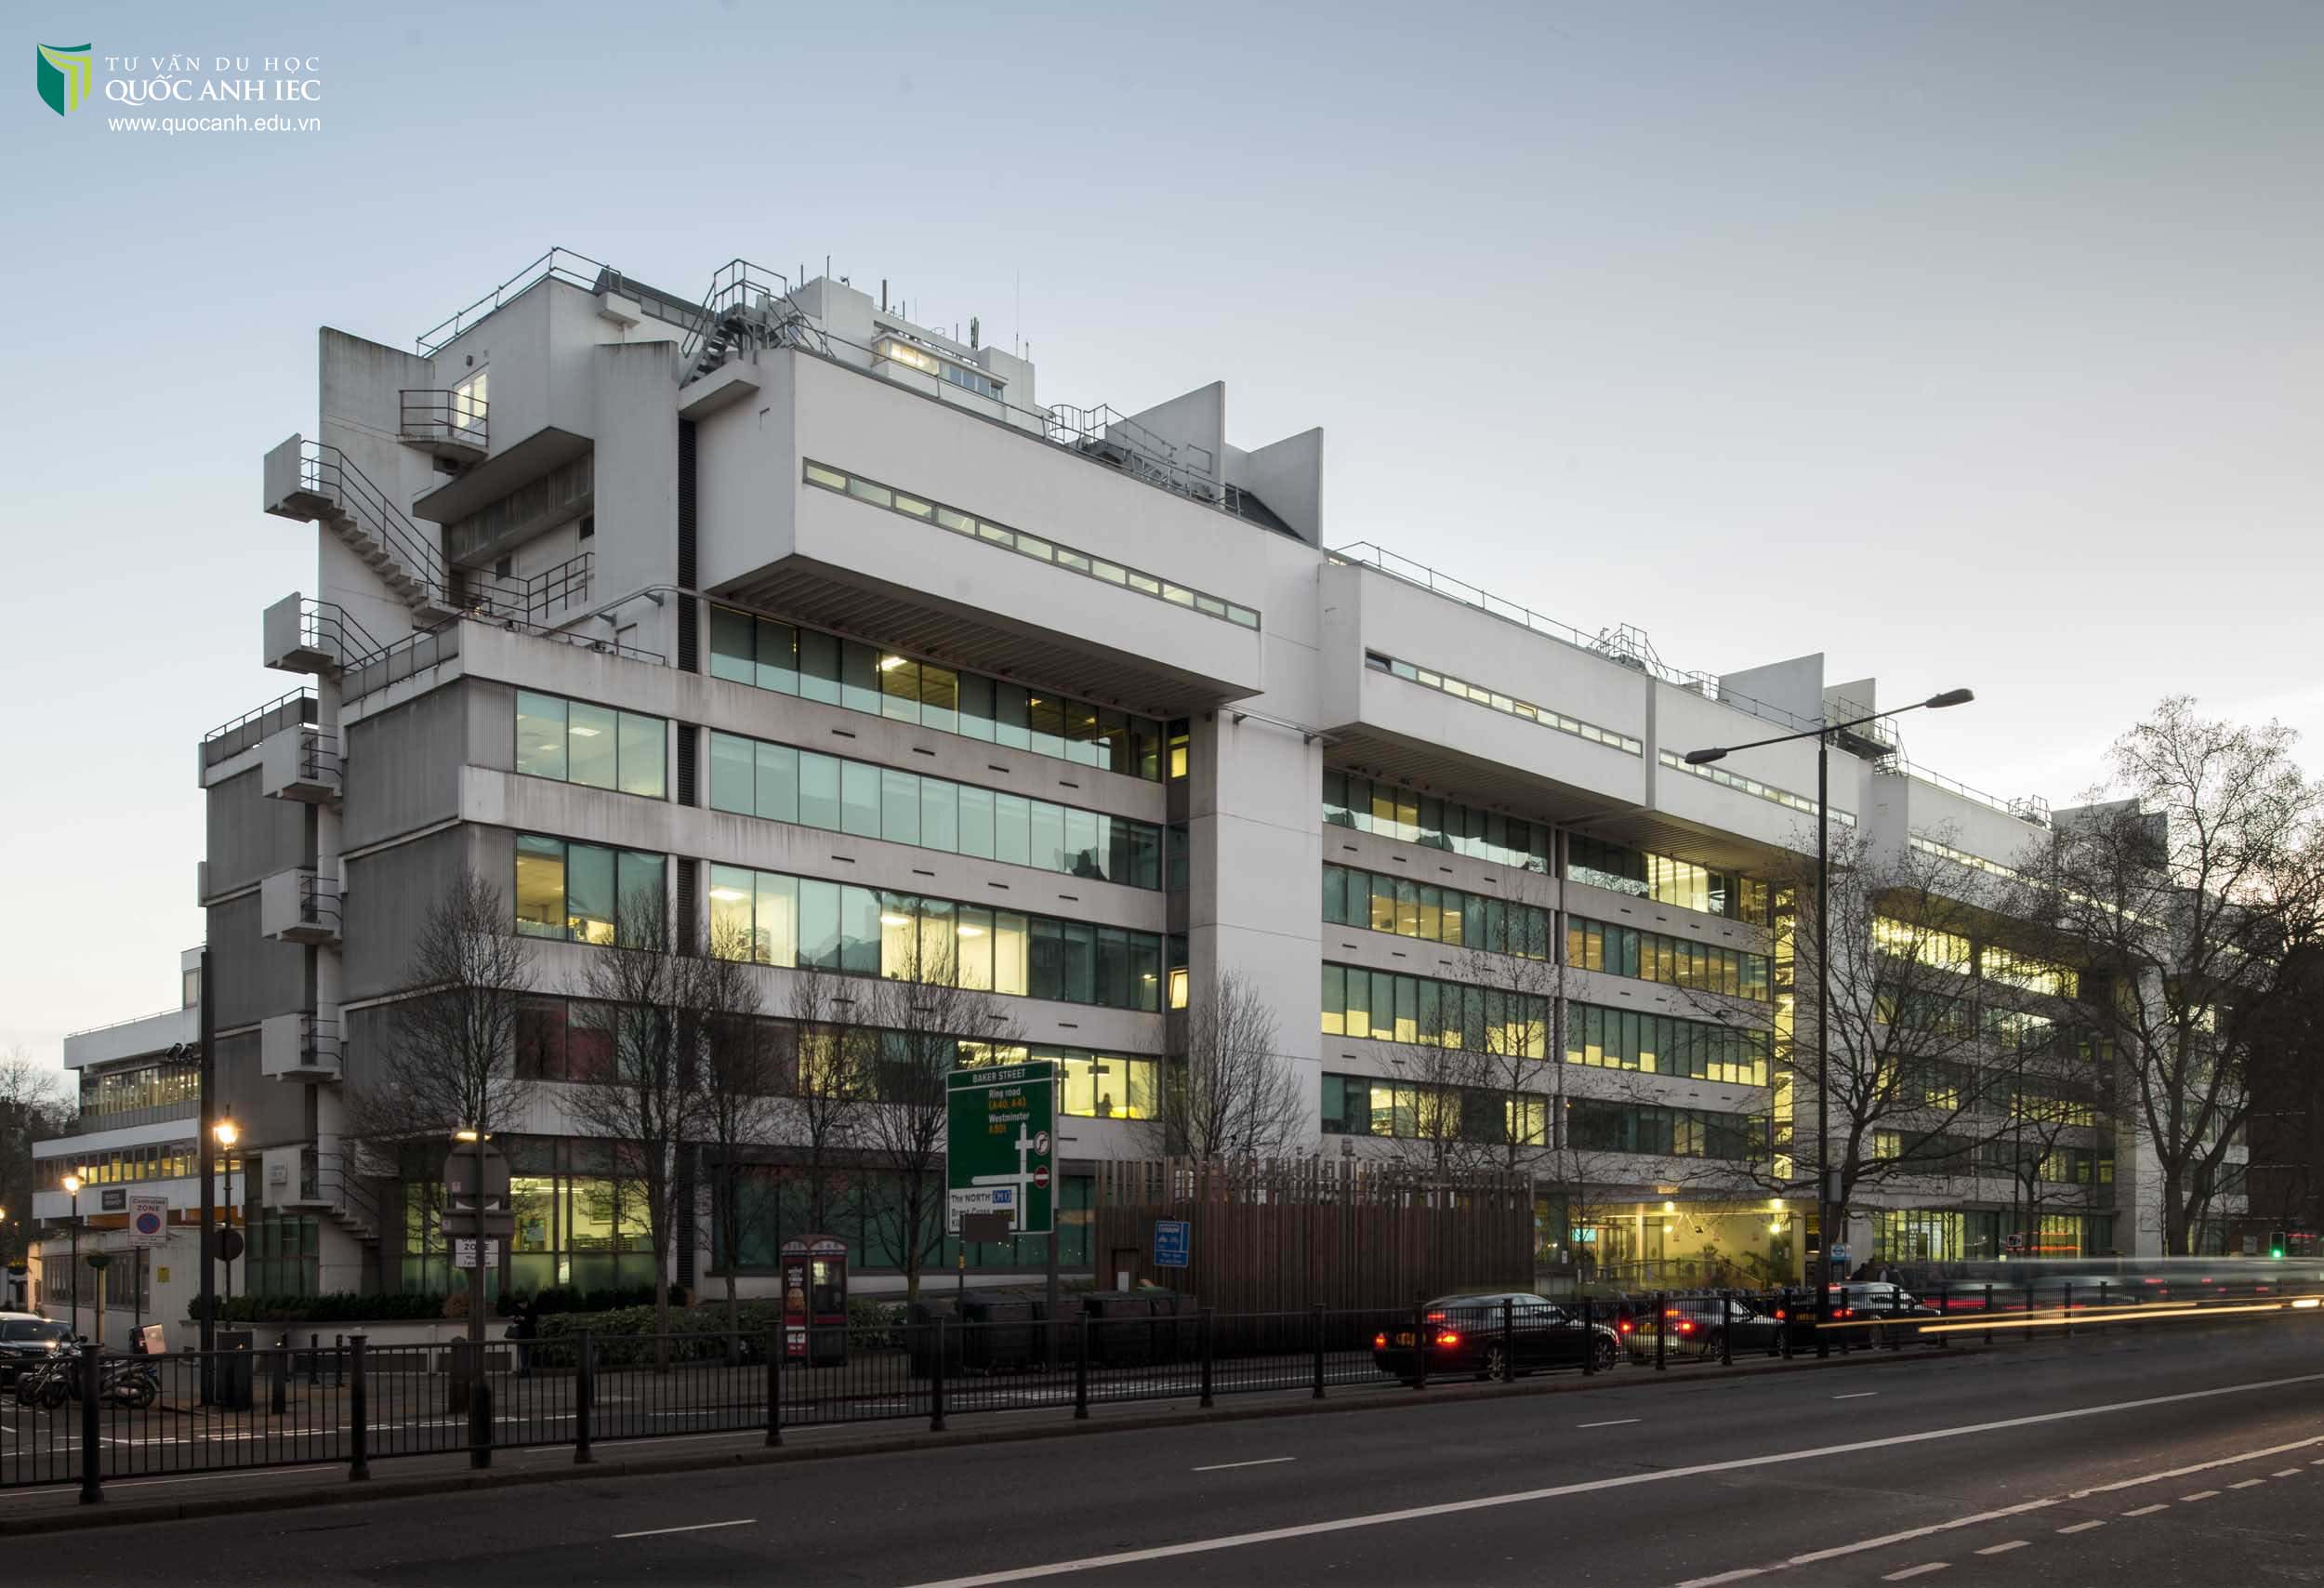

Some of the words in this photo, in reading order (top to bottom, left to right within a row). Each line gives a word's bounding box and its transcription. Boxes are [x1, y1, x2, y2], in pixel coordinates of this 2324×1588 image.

[972, 1071, 997, 1083] BAKER
[997, 1068, 1026, 1080] STREET
[988, 1112, 1030, 1123] Westminster
[965, 1193, 991, 1203] NORTH
